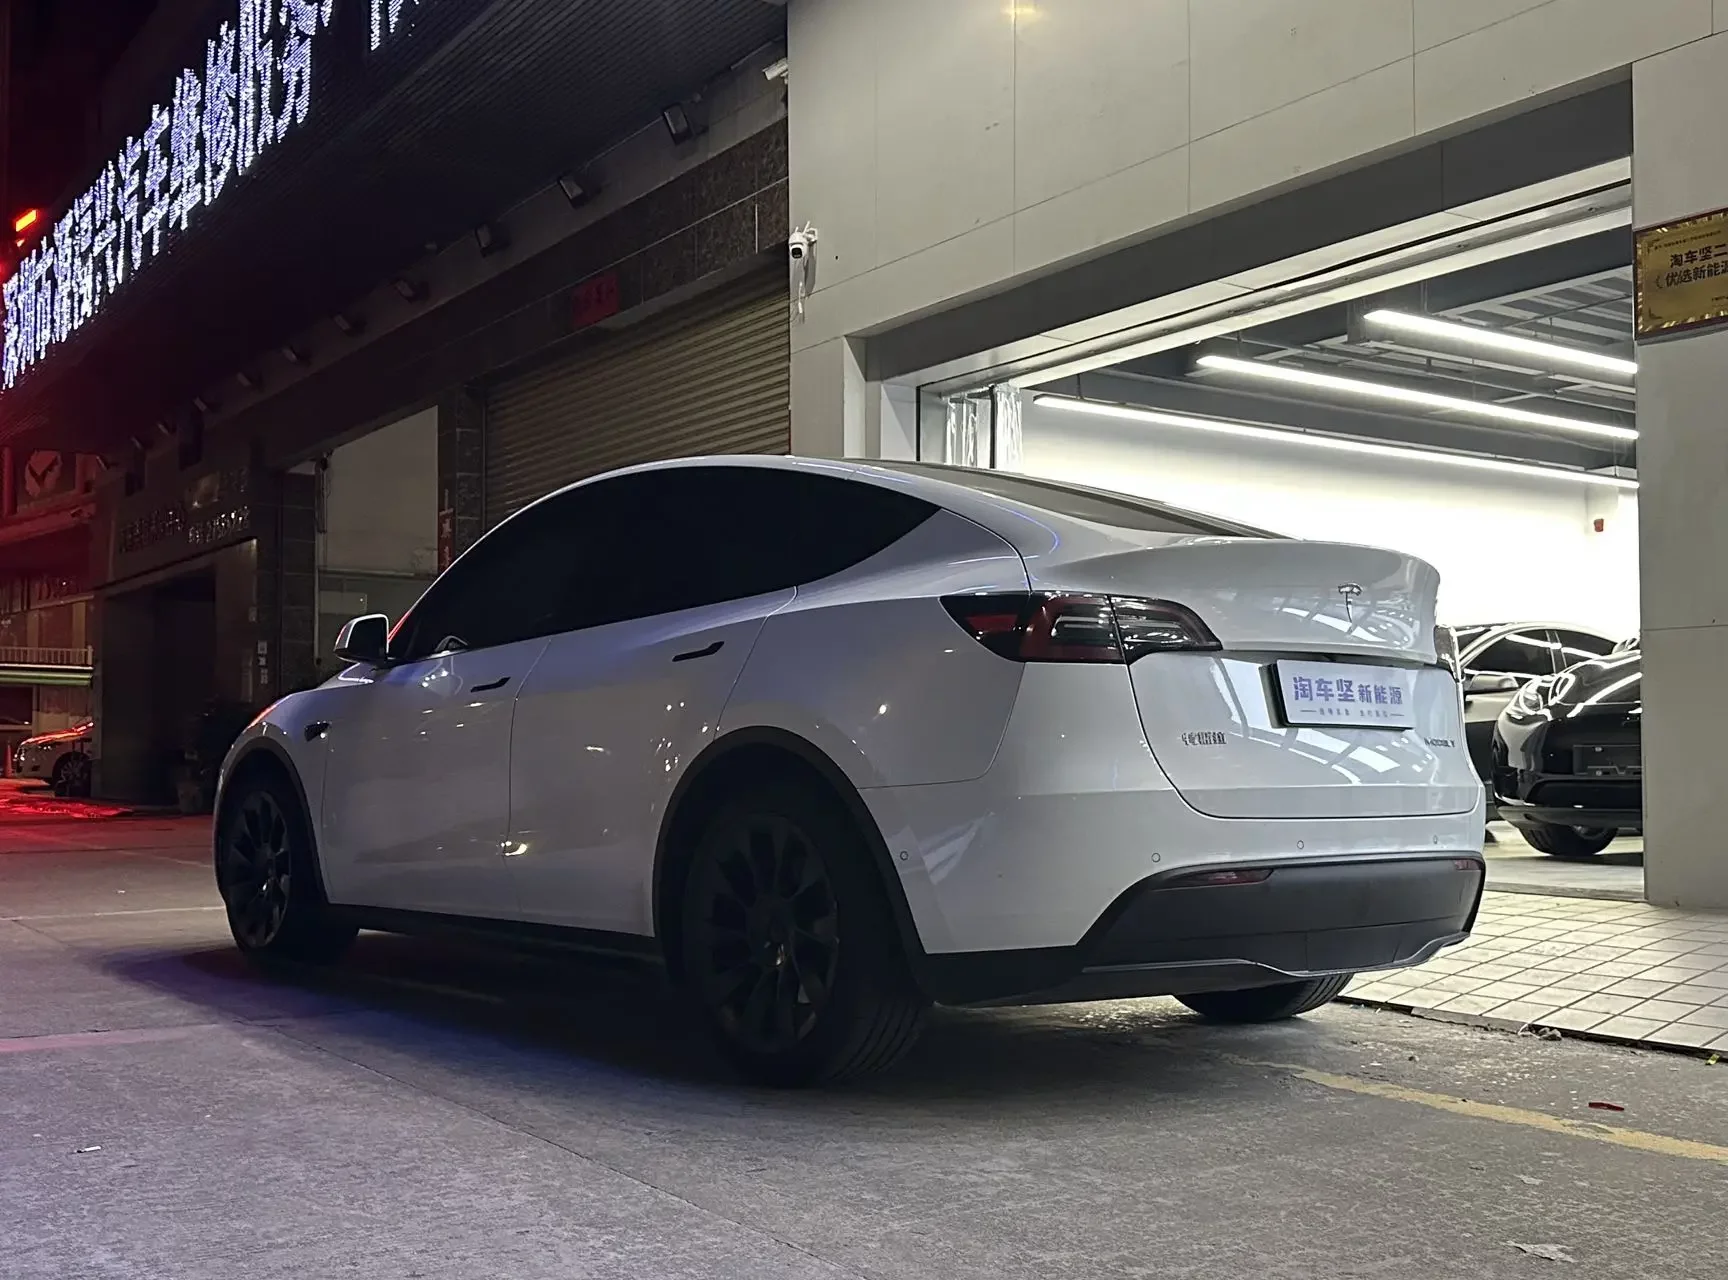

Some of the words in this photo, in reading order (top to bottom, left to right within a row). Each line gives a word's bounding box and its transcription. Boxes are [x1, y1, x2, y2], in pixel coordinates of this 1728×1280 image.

[1, 0, 418, 390] 深圳市源福兴汽车维修服务
